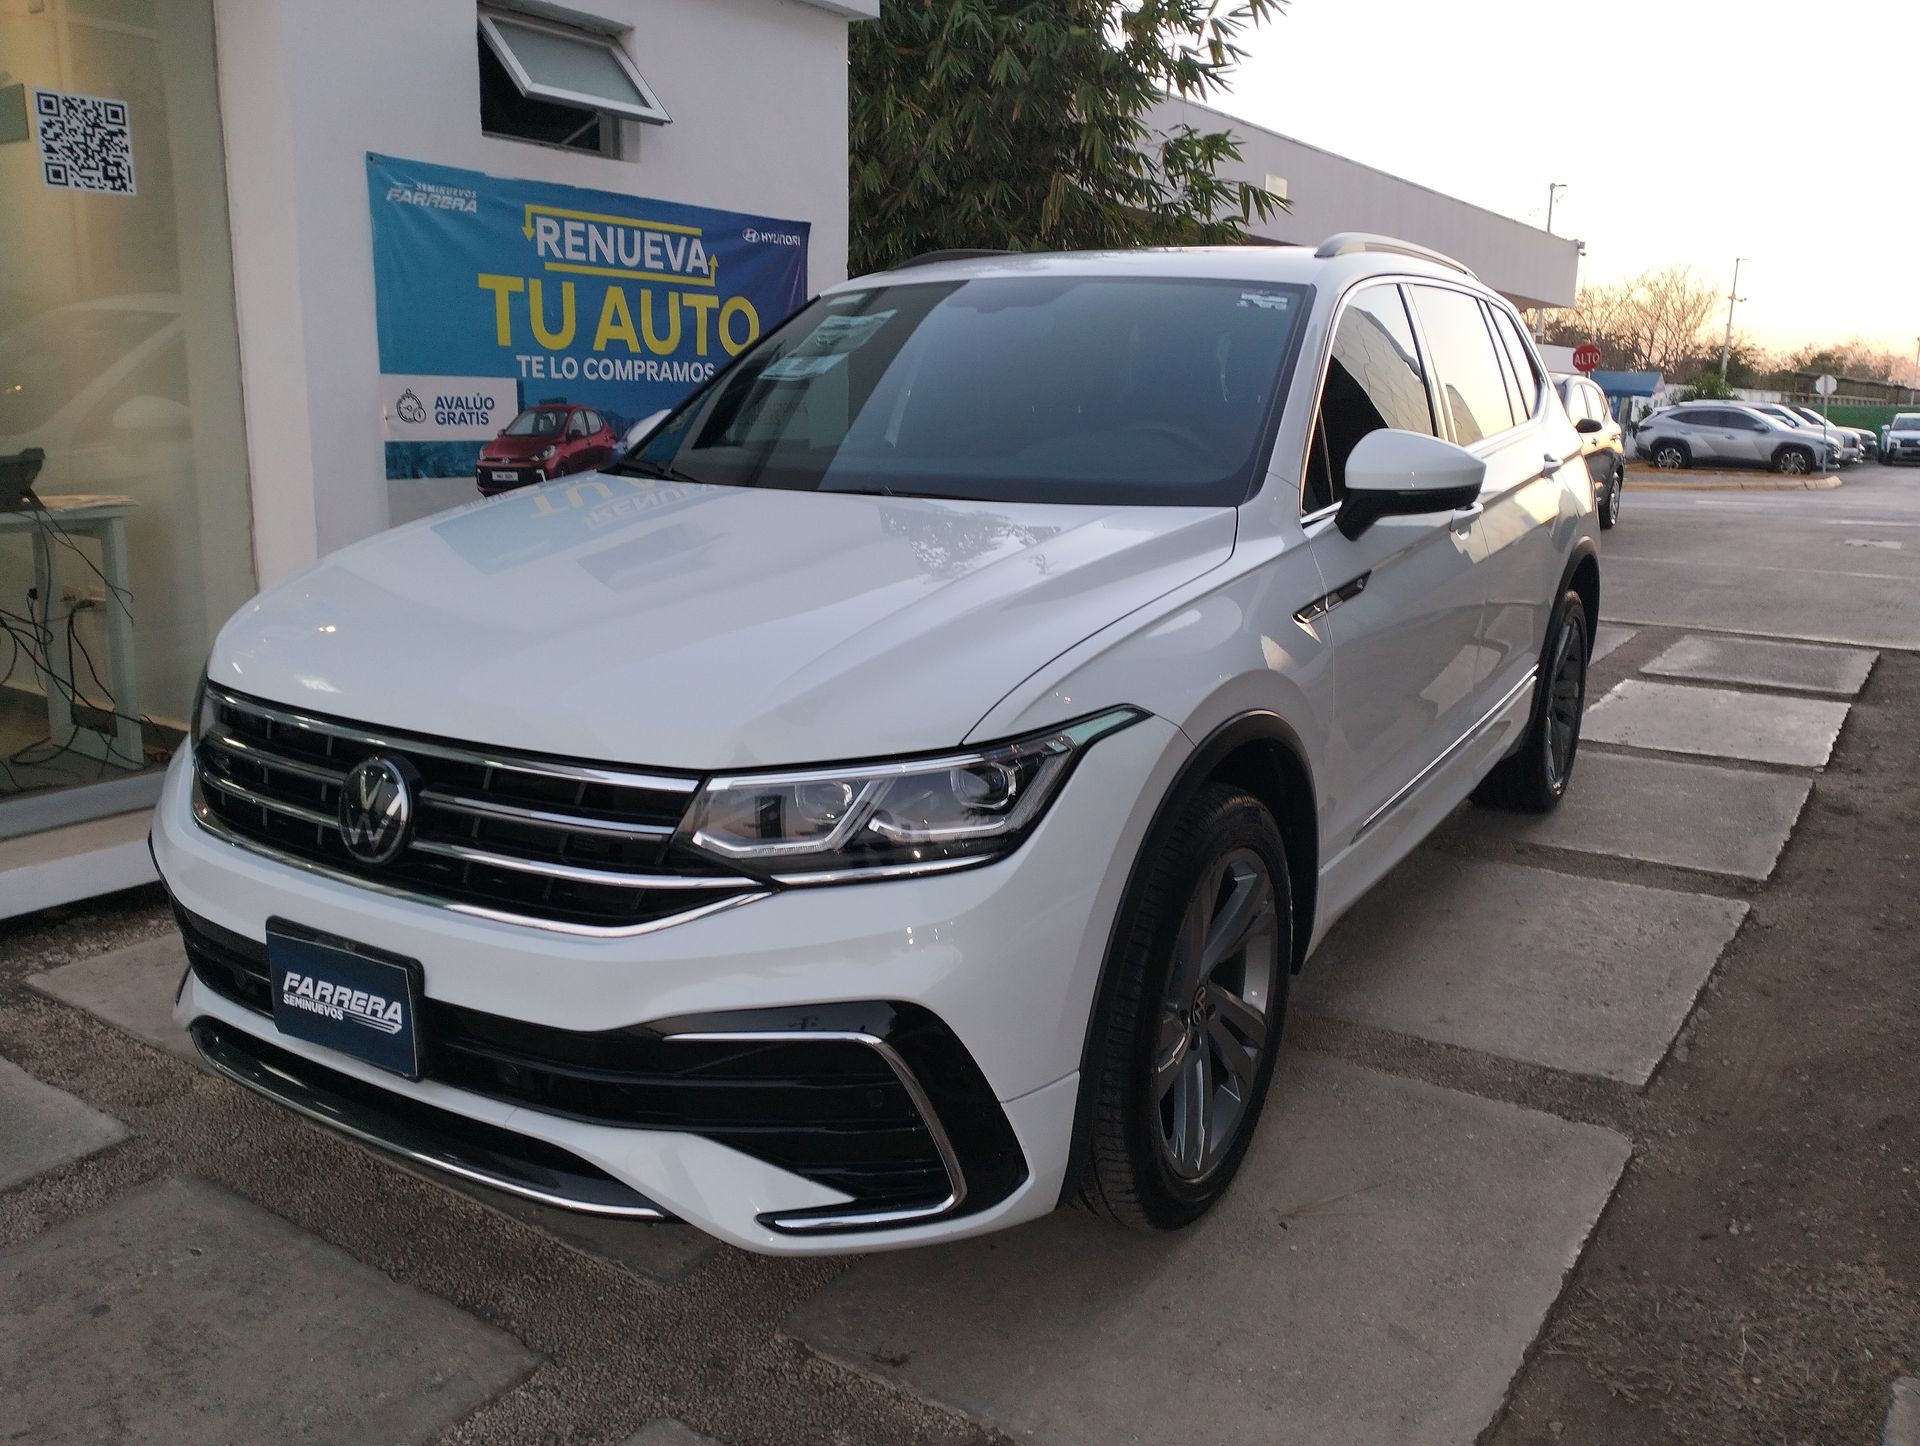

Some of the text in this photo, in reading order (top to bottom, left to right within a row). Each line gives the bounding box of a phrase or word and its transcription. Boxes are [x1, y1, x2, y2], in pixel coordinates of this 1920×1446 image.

[386, 187, 477, 213] FARRERA
[416, 182, 477, 199] SEMINUEVOS
[536, 216, 709, 275] RENUEVA
[761, 232, 801, 246] HYUNDAI
[478, 273, 760, 357] TU AUTO
[516, 354, 715, 383] TE LO COMPRAMOS
[1575, 352, 1600, 365] ALTO
[434, 392, 495, 410] AVALÚO
[435, 409, 490, 425] GRATIS
[283, 971, 402, 1024] FARRERA
[283, 993, 344, 1021] SEMINUEVOS
